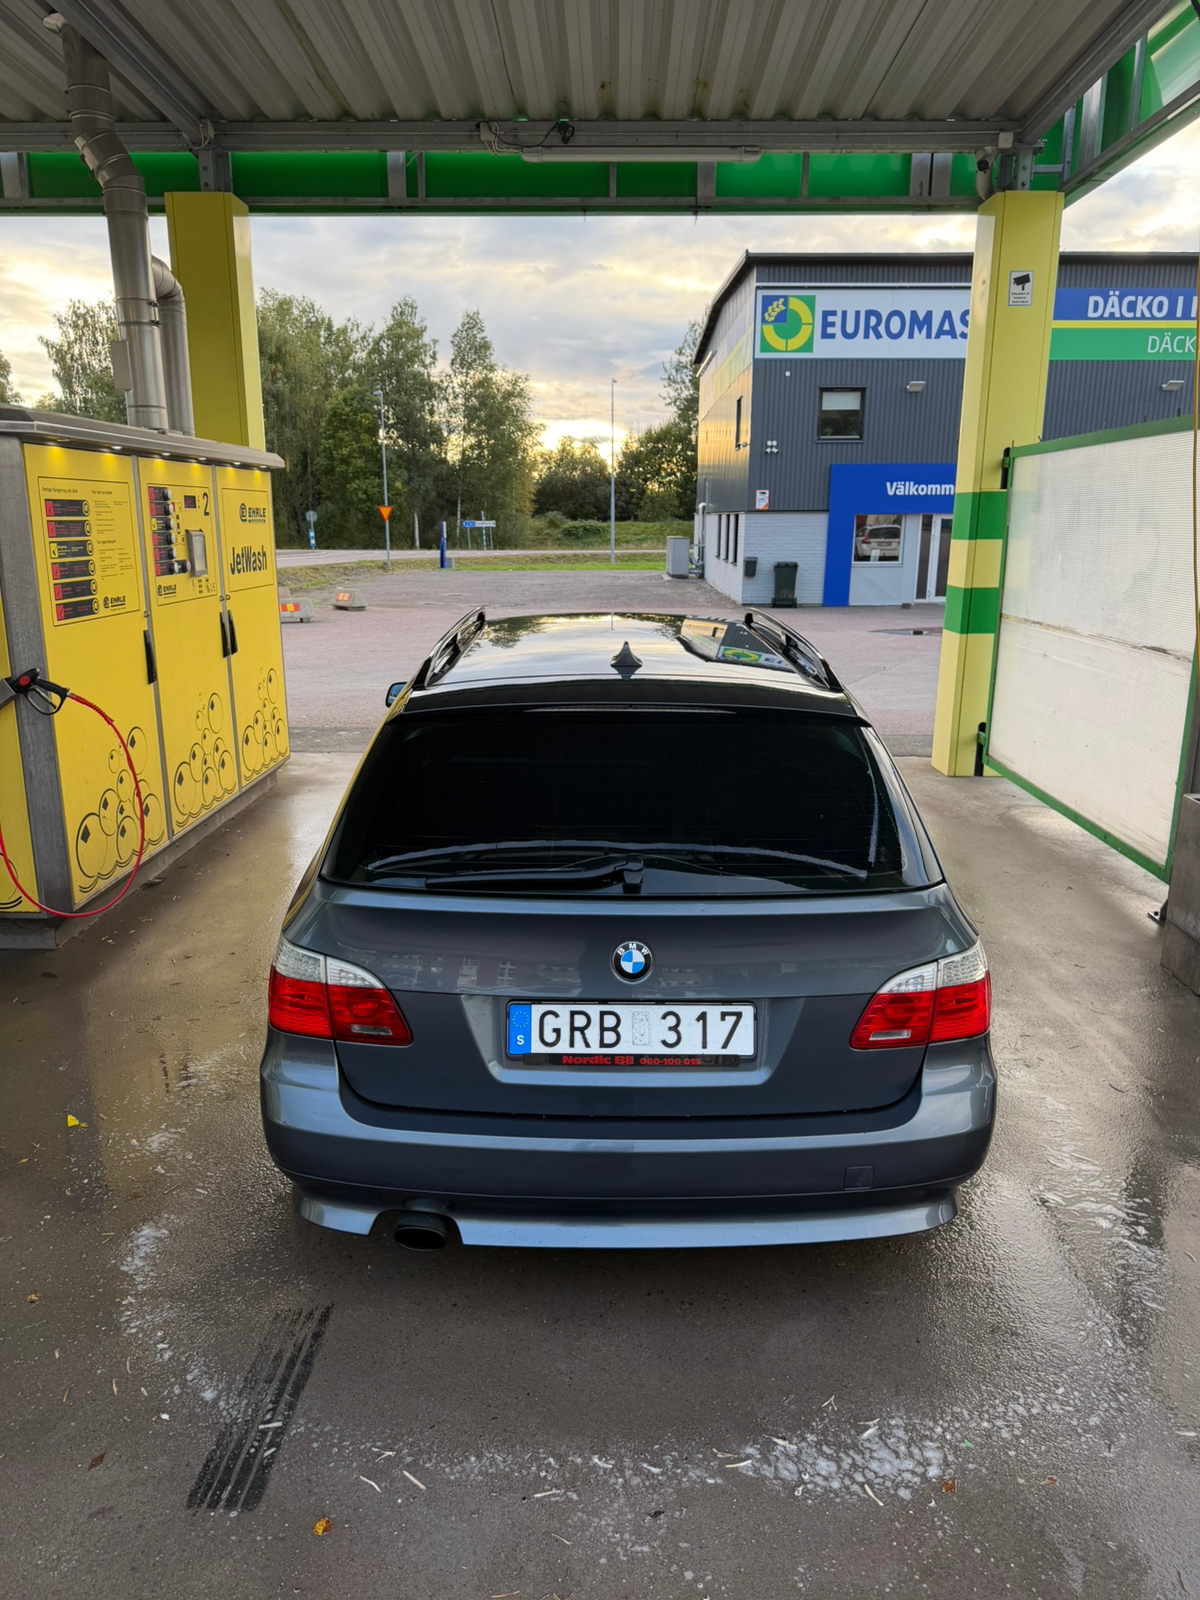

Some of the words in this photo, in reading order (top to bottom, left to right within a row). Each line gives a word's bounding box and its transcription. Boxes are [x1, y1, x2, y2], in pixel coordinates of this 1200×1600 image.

[1087, 290, 1169, 318] DÄCKO
[1176, 295, 1184, 318] I
[820, 309, 970, 340] EUROMAS
[1147, 332, 1197, 353] DÄCK
[886, 481, 954, 496] Välkomm
[202, 492, 210, 517] 2
[248, 507, 266, 518] EHRLE
[230, 544, 268, 575] JetWash
[617, 943, 650, 956] BMW
[516, 1034, 525, 1046] S
[539, 1009, 622, 1049] GRB
[661, 1010, 743, 1050] 317
[561, 1055, 612, 1065] Nordic
